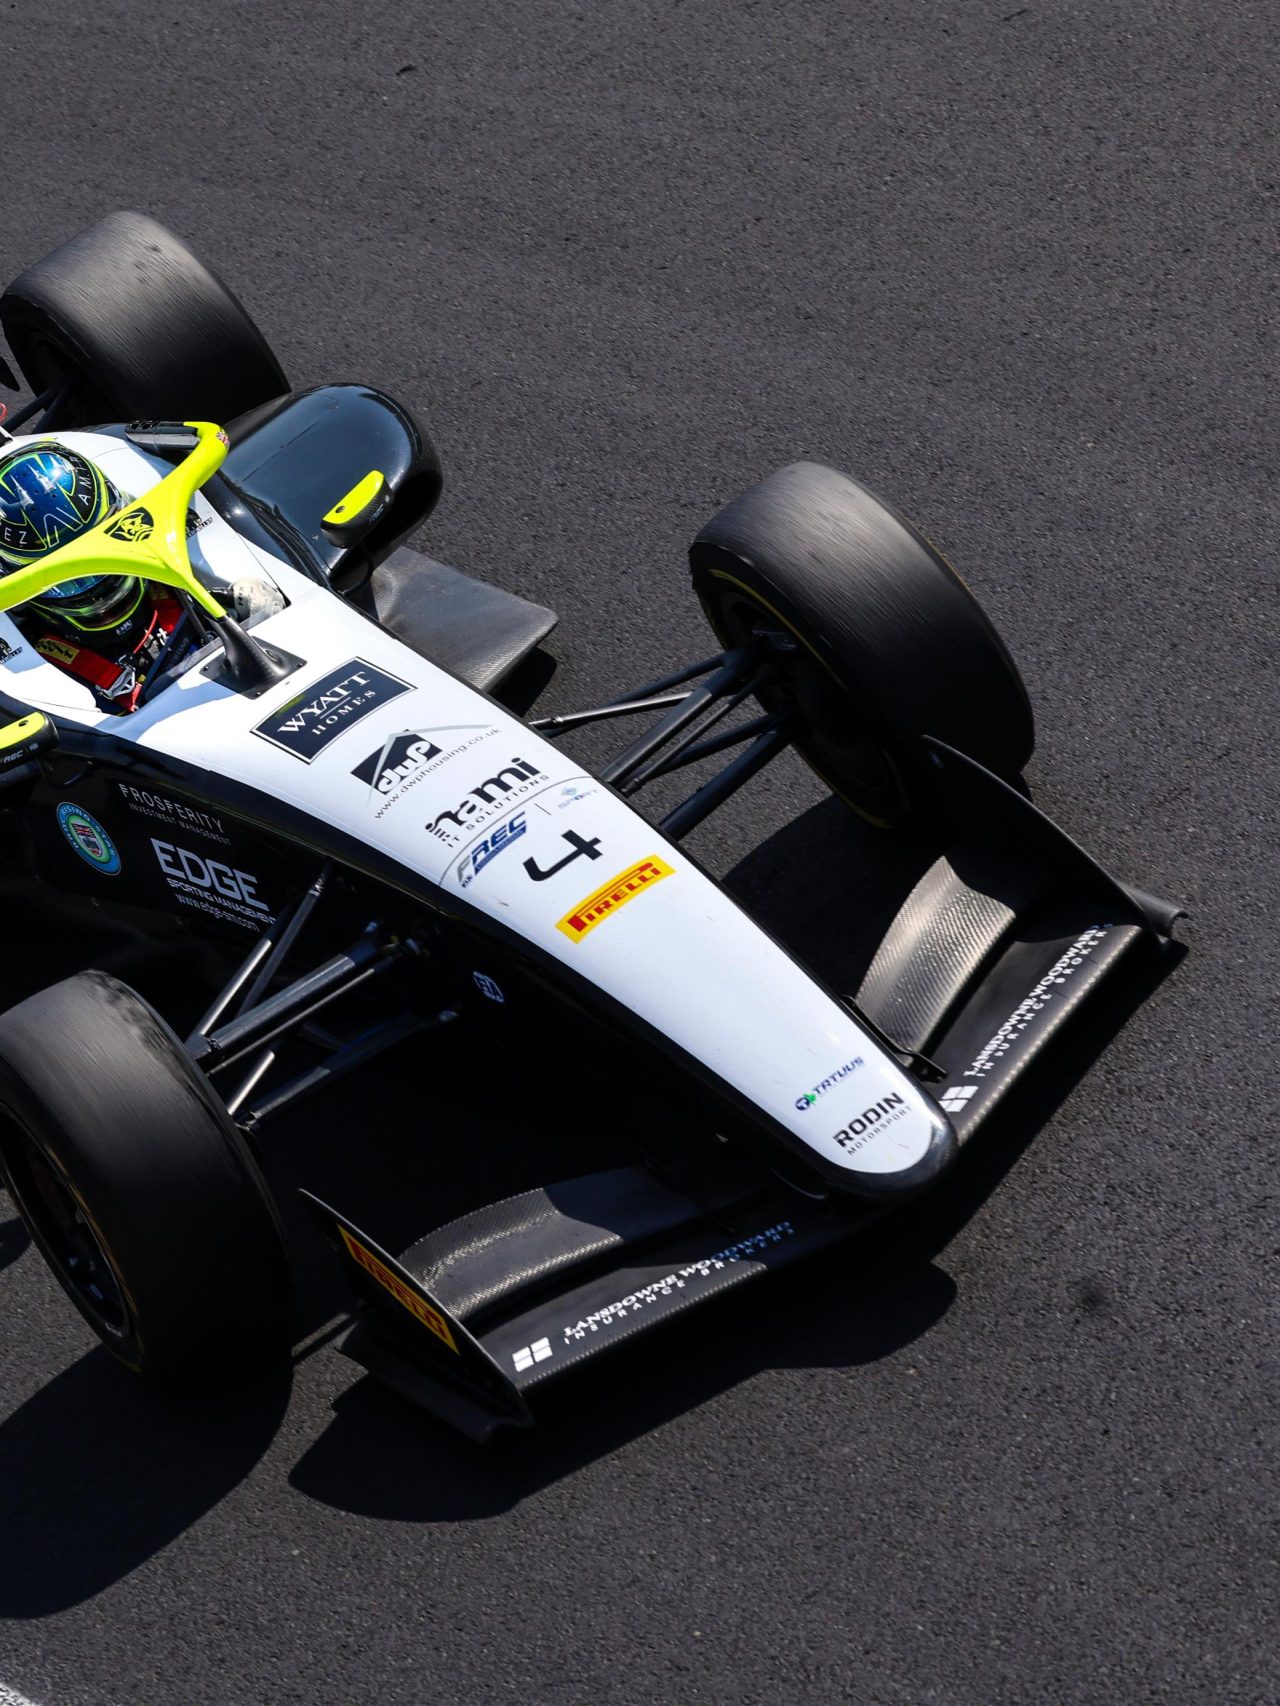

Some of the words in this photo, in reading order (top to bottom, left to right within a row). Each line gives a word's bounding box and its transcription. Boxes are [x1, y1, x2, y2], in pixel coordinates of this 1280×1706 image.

[277, 671, 371, 733] WYATT
[312, 690, 376, 735] HOMES
[374, 728, 502, 819] www.dwphousing.co.uk
[129, 803, 177, 825] INVESTMENT
[179, 820, 231, 846] MANAGEMENT
[447, 835, 461, 848] IT
[466, 774, 550, 831] SOLUTIONS
[150, 838, 270, 912] EDGE
[457, 811, 527, 883] FREC
[523, 829, 603, 882] 4
[166, 877, 215, 902] SPORTING
[214, 895, 277, 925] MANAGEMENT
[567, 862, 661, 932] PIRELLI
[976, 993, 1052, 1077] INSURANCE
[832, 1092, 905, 1148] RODIN
[847, 1105, 913, 1156] MOTORSPORT
[563, 1273, 678, 1337] LANSDOWNE
[678, 1221, 791, 1278] WOODWARD
[564, 1279, 686, 1345] INSURANCE
[700, 1227, 795, 1277] BROKERS
